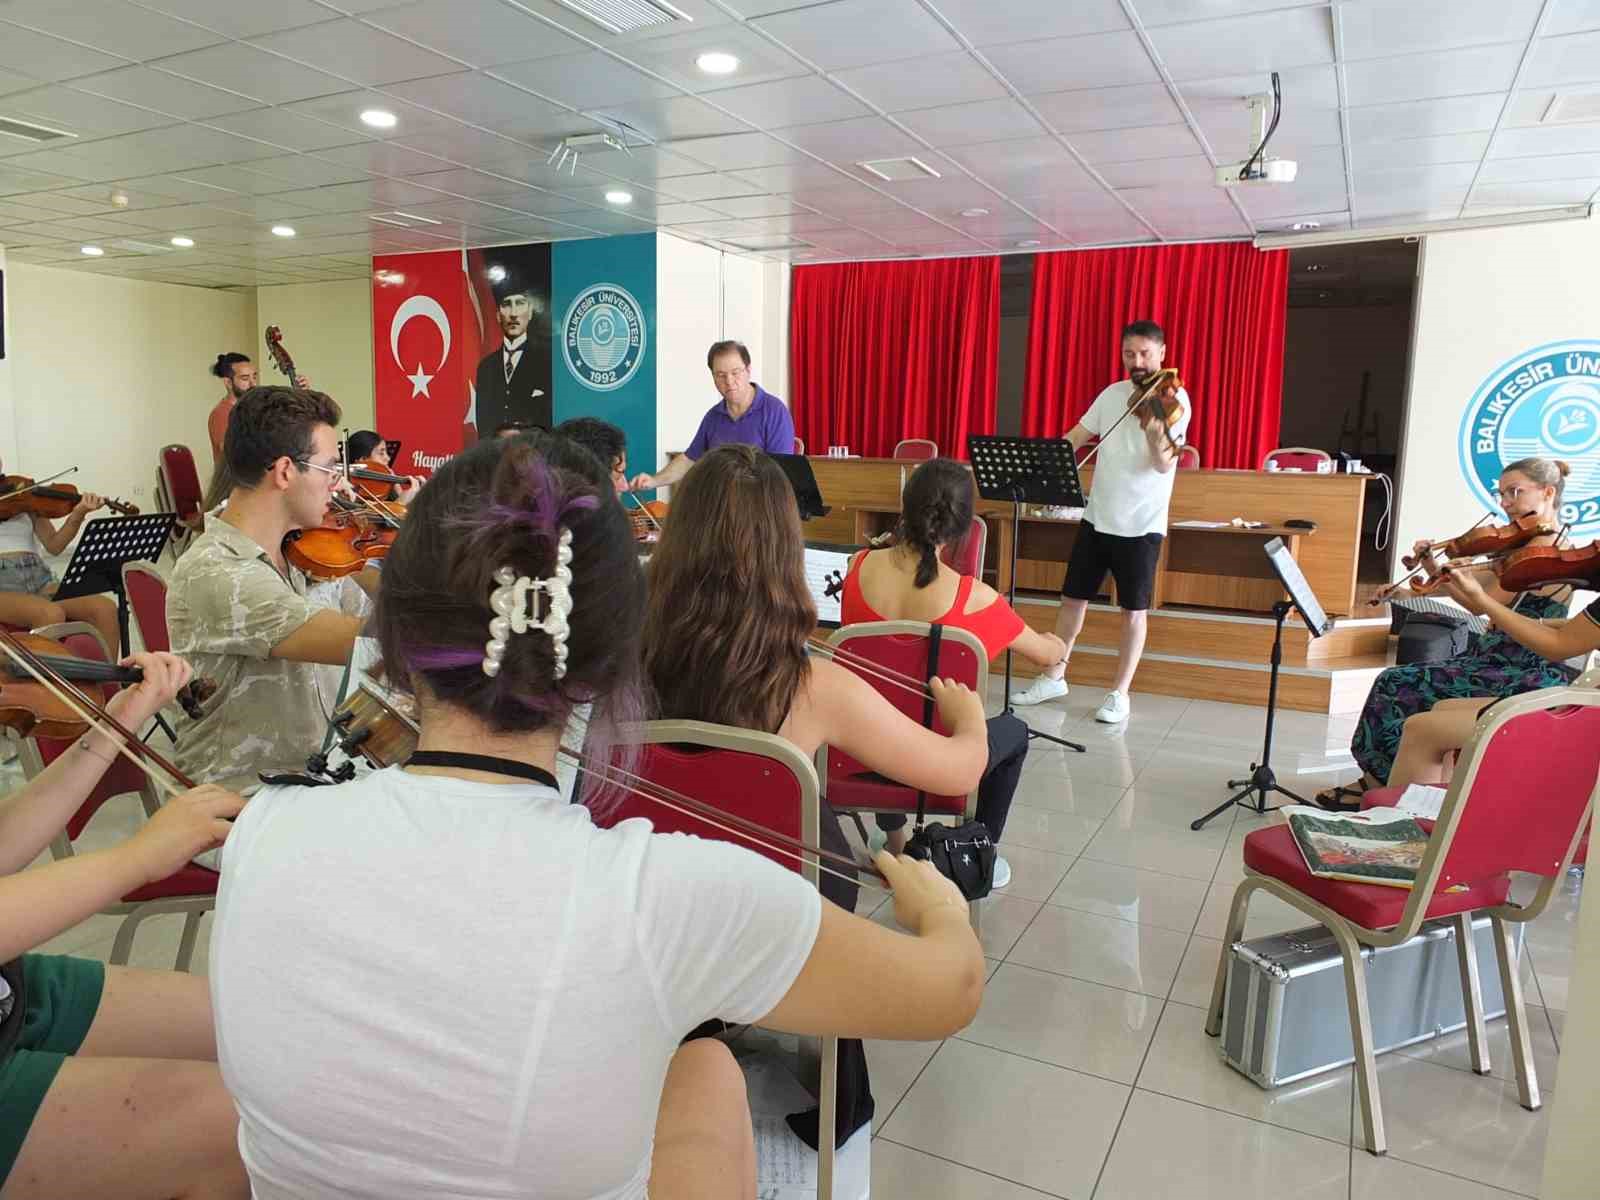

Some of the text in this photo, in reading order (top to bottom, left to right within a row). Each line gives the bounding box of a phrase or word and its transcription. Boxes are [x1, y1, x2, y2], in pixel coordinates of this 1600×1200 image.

[568, 291, 640, 347] BALIKESİR ÜNİVERSİTESİ
[590, 370, 618, 384] 1992
[1477, 352, 1600, 454] BALIKESİR ÜN
[1559, 502, 1599, 523] 92
